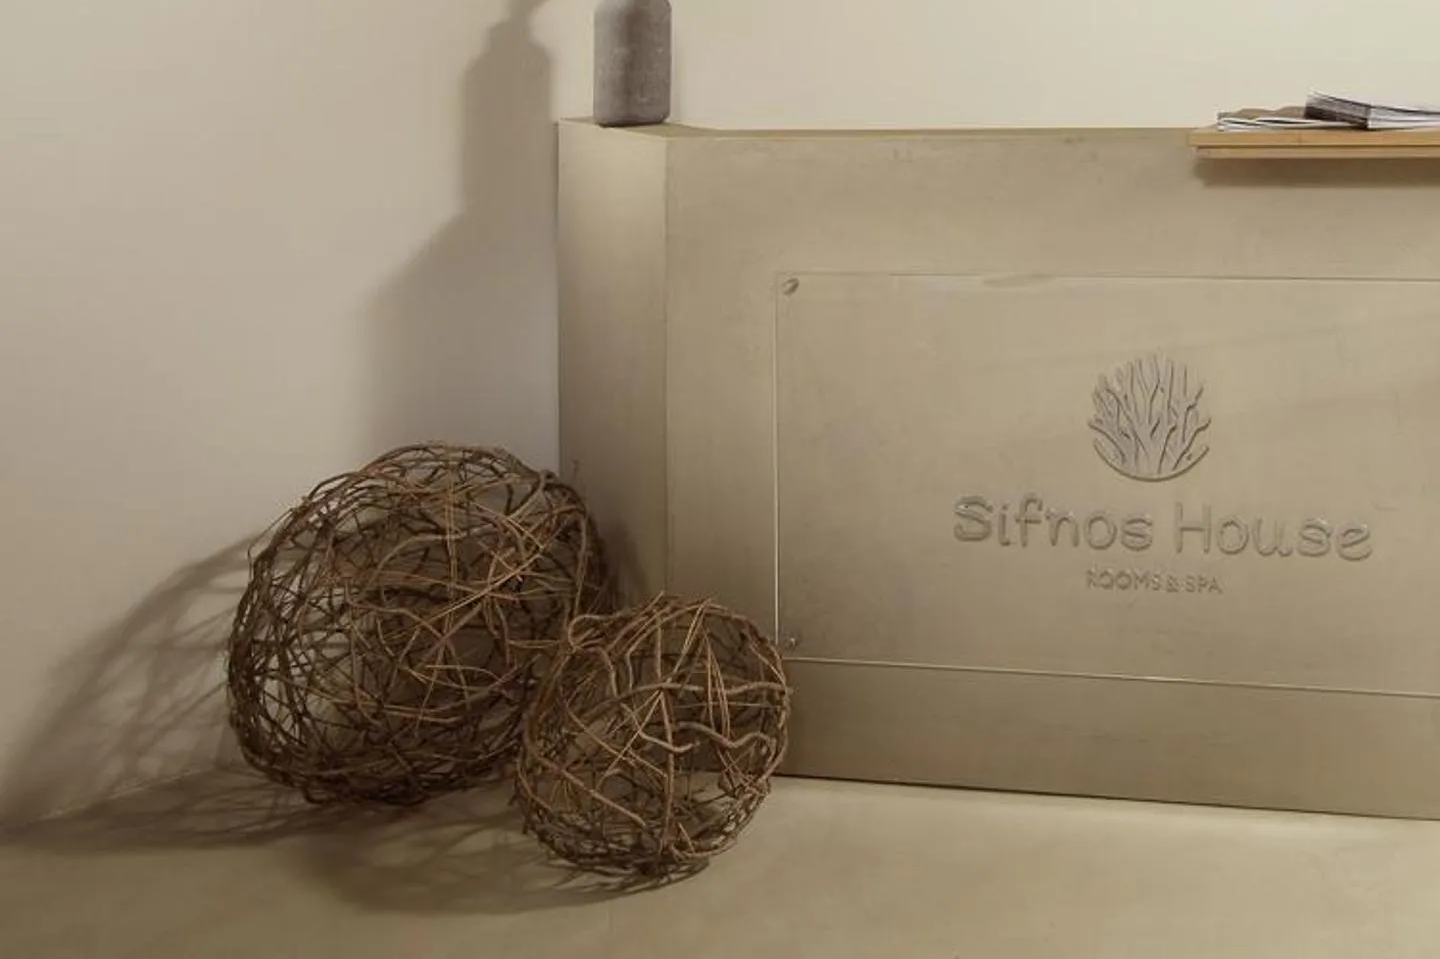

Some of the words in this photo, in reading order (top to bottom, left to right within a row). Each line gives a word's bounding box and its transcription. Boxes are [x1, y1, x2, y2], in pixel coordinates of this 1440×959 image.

[952, 494, 1155, 551] Sifnos
[1173, 501, 1374, 561] House
[1086, 569, 1161, 592] ROOMS
[1185, 575, 1223, 594] SPA
